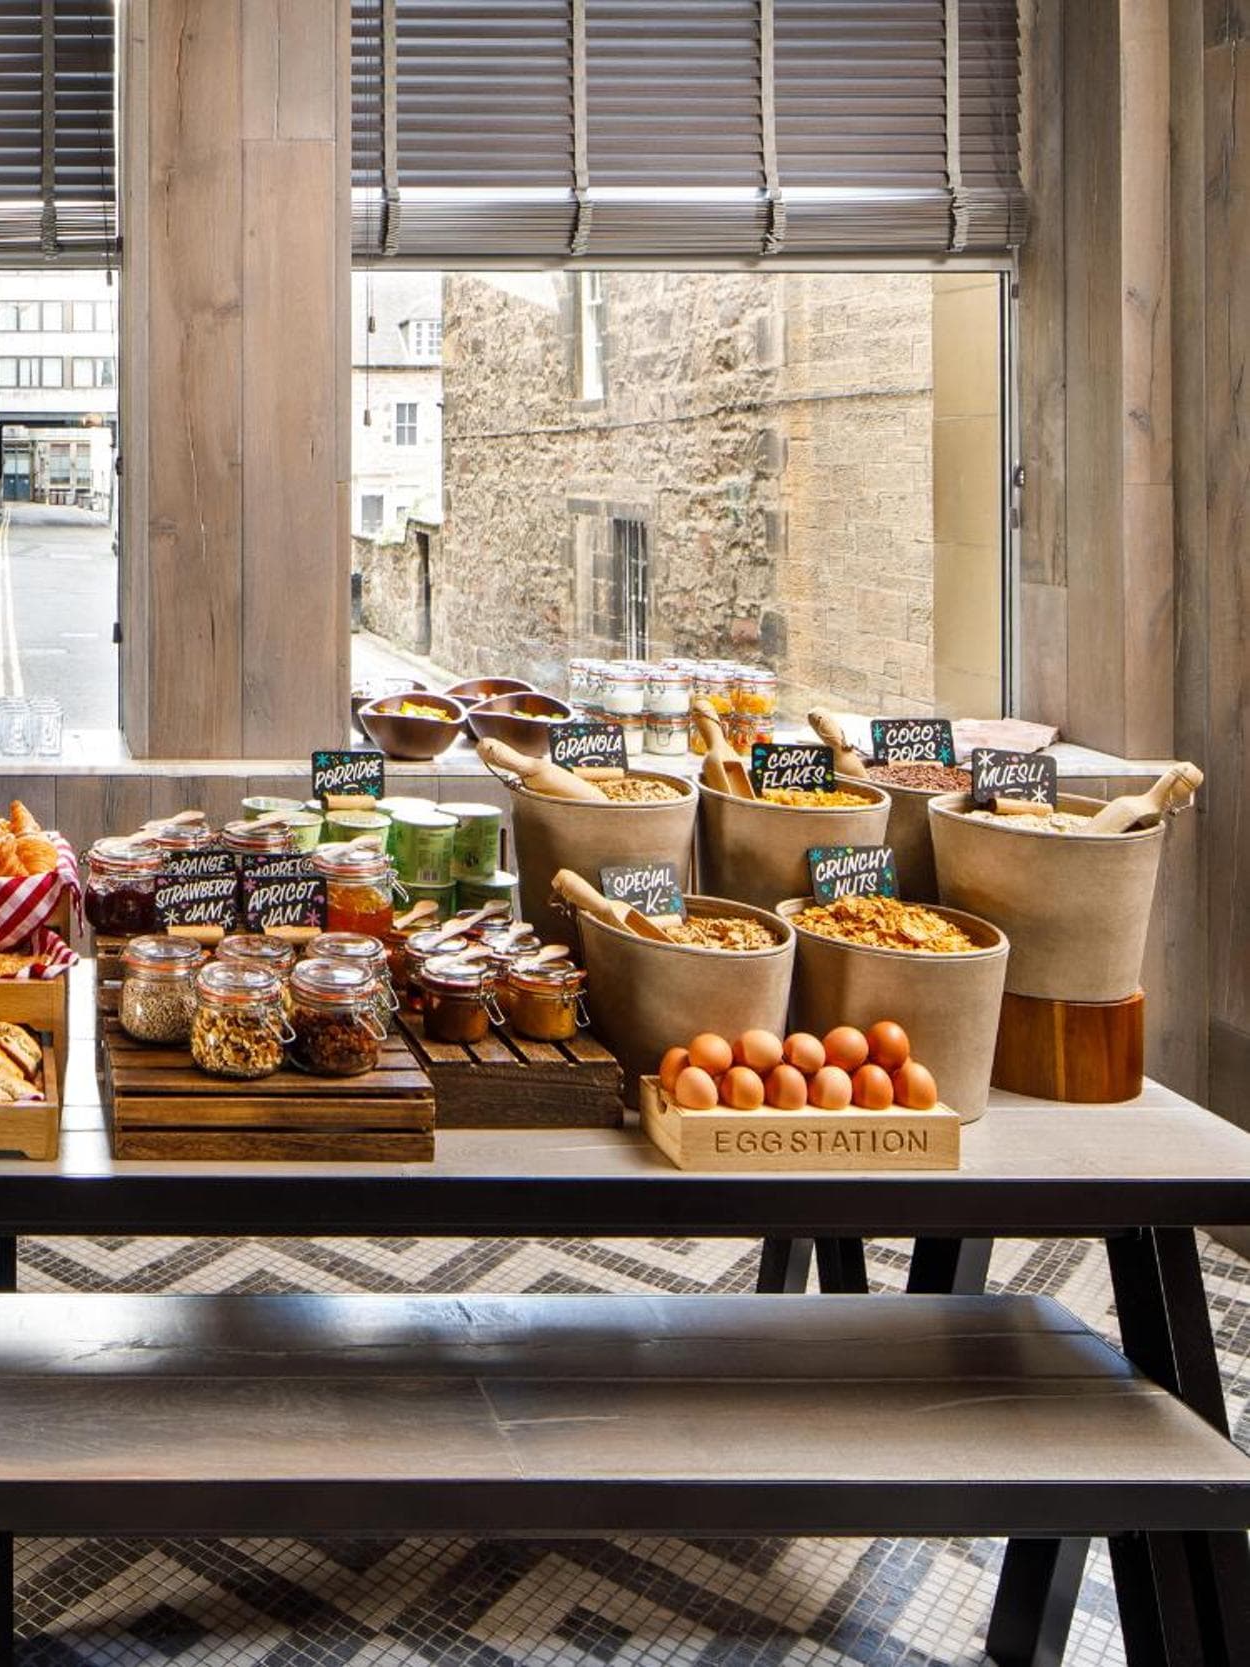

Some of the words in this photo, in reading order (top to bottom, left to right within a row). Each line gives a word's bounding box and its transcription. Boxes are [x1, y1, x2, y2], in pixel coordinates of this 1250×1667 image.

[554, 734, 622, 761] GRANOLA
[886, 725, 934, 746] COCO
[767, 749, 819, 769] CORN
[888, 741, 936, 761] POPS
[314, 760, 382, 790] PORRIDGE
[761, 765, 826, 789] FLAKES
[977, 763, 1044, 790] MUESLI
[816, 848, 892, 883] CRUNCHY
[155, 879, 237, 909] STRAWBERRY
[248, 881, 320, 911] APRICOT
[613, 868, 674, 898] SPECIAL
[834, 872, 877, 899] NUTS
[184, 901, 224, 922] JAM
[261, 904, 302, 928] JAM
[714, 1130, 783, 1153] EGG
[790, 1129, 928, 1153] STATION
